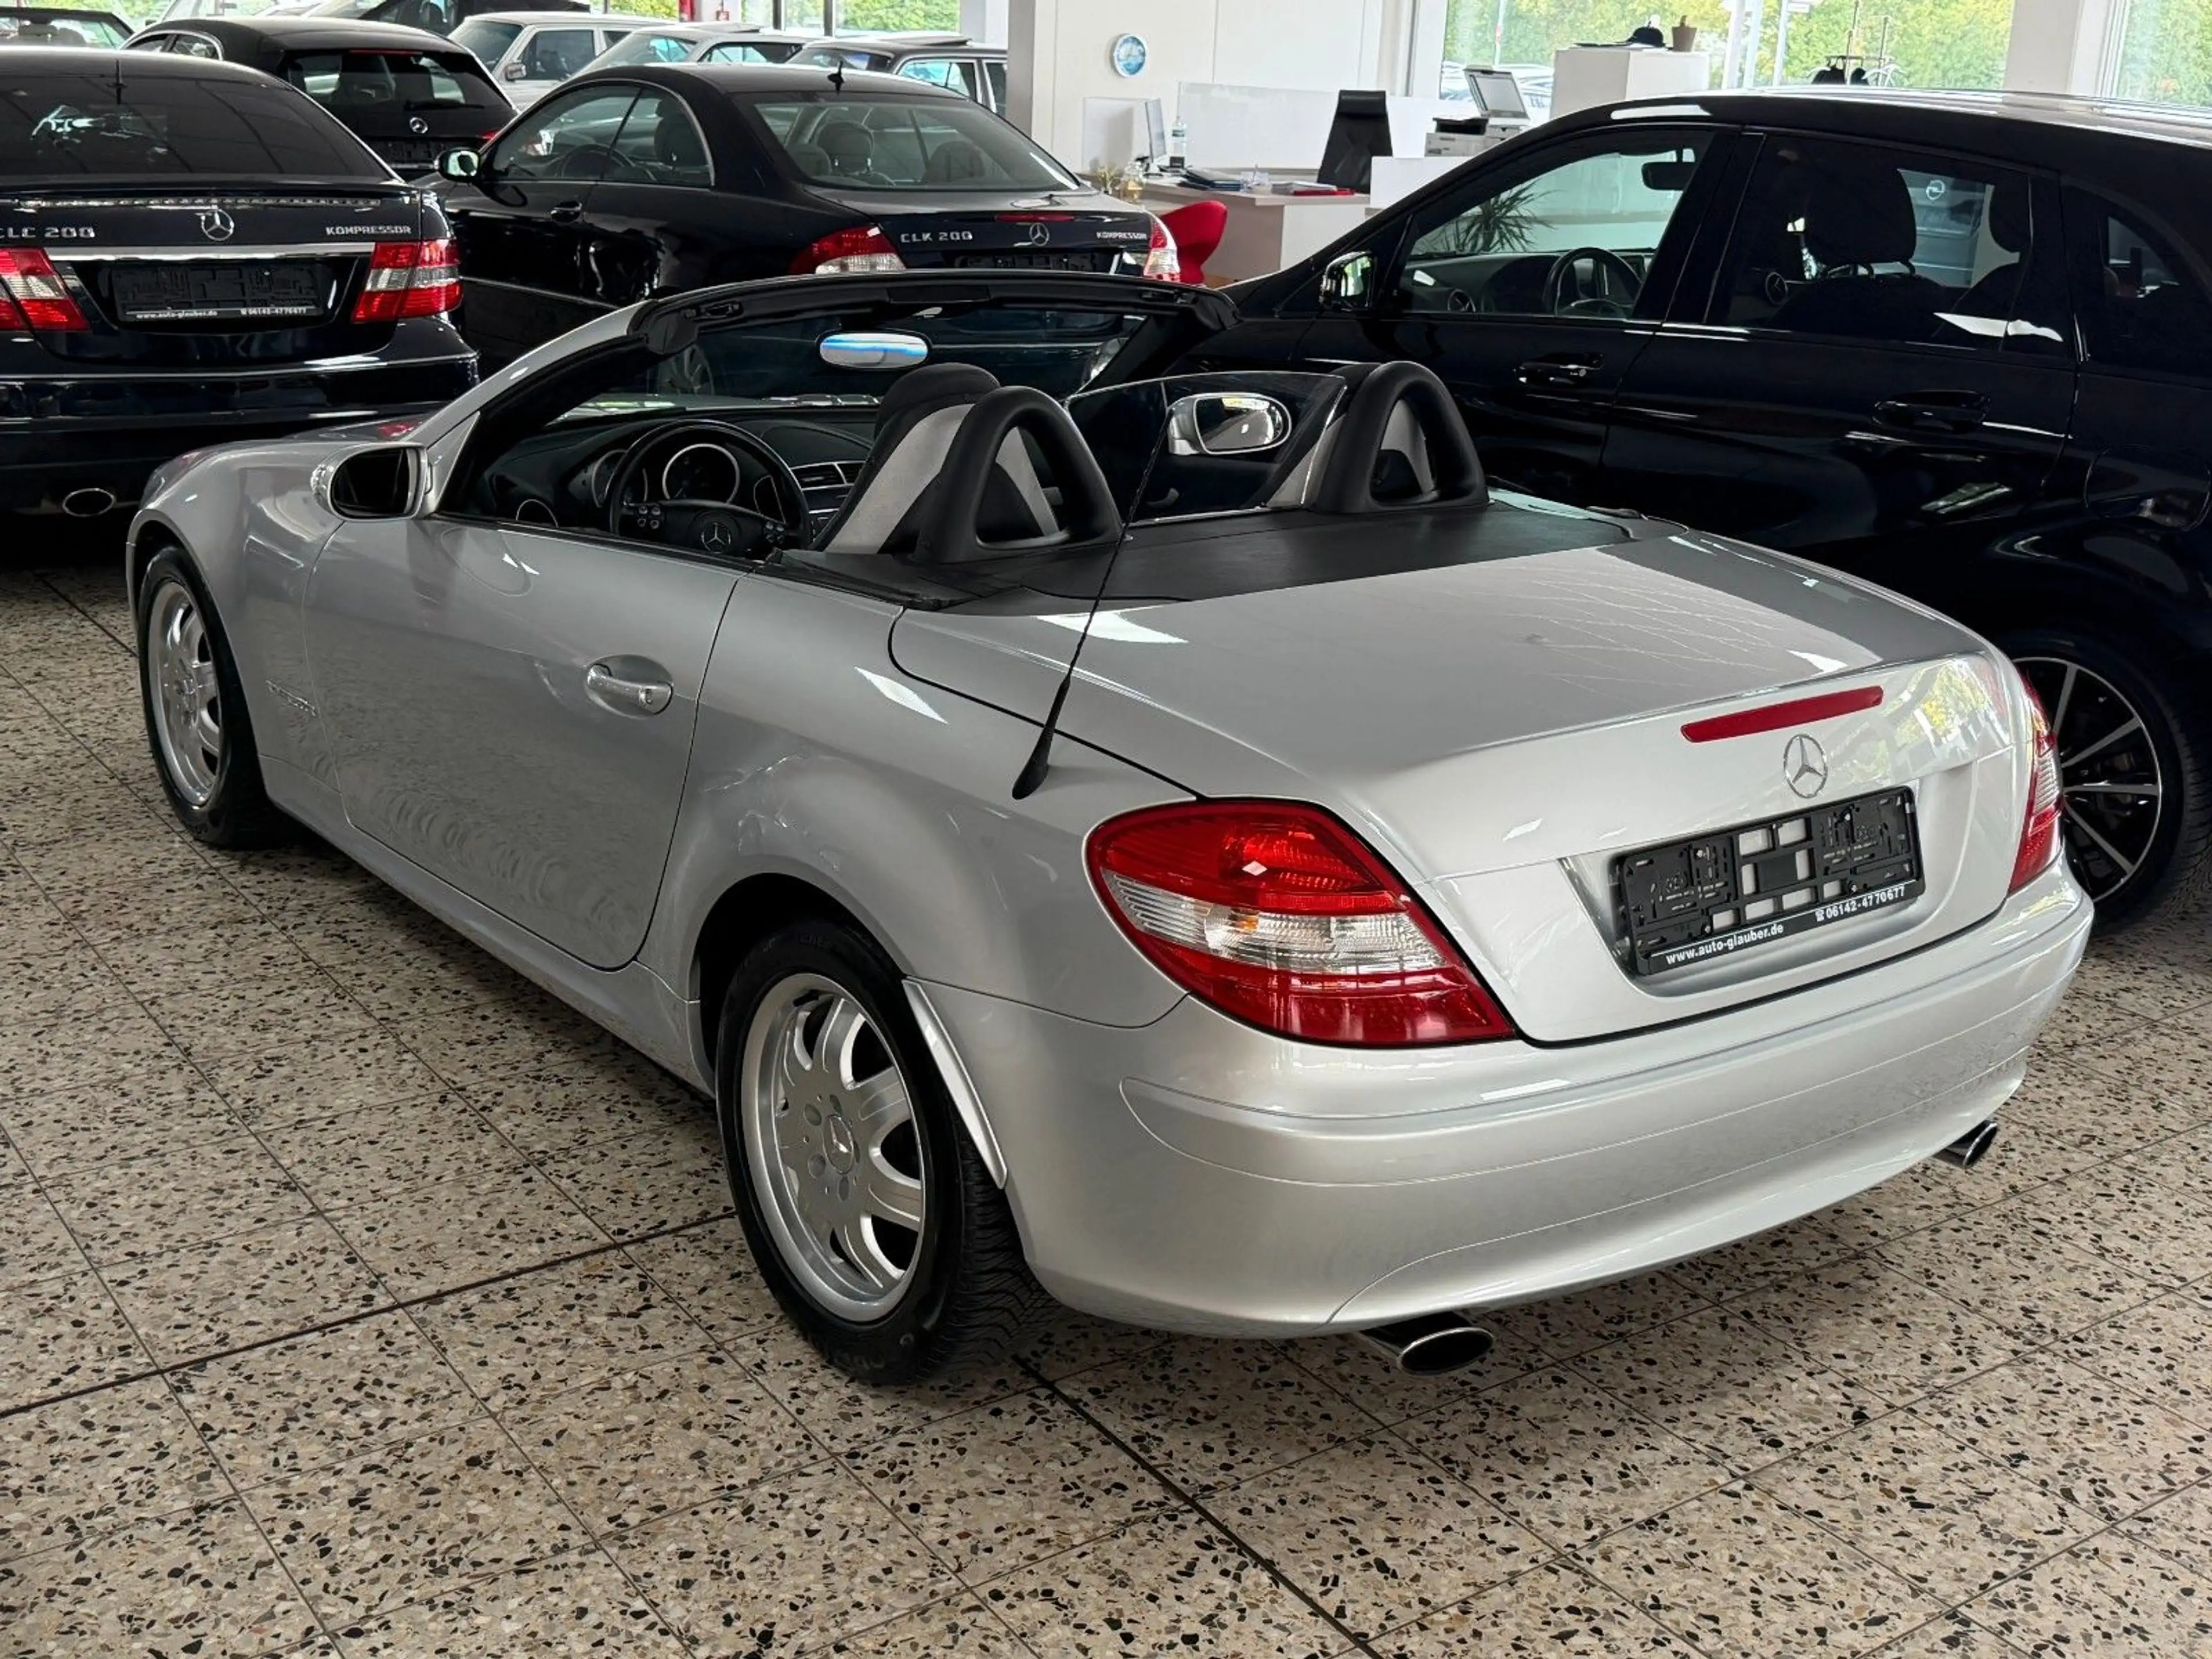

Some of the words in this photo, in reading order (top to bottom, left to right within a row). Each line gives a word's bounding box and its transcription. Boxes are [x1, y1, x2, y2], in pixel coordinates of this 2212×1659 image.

[44, 227, 95, 238] 200
[325, 226, 412, 235] KOMPRESSOR
[900, 232, 933, 243] CLK
[938, 231, 972, 241] 200
[1666, 922, 1784, 964] www.auto-glauber.de
[1826, 886, 1905, 919] 06142-4770677
